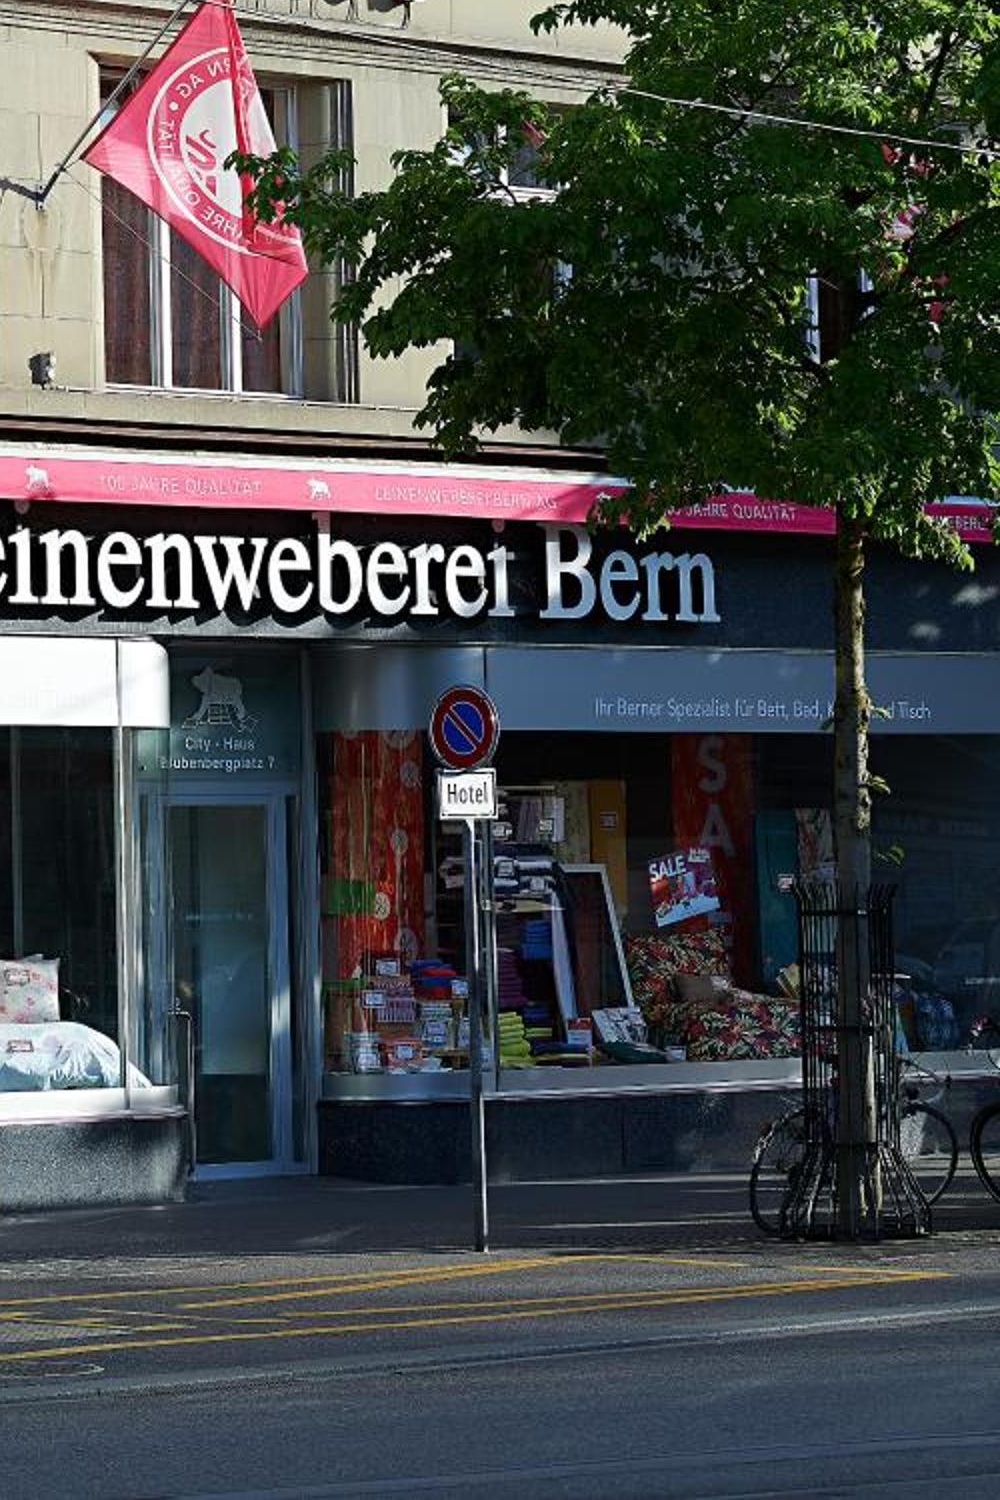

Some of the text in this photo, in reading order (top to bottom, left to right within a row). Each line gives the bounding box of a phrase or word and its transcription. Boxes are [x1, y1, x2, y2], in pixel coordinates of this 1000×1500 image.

[538, 521, 722, 623] Bern
[594, 697, 615, 717] Ihr
[617, 698, 663, 717] Berner
[667, 697, 731, 722] Spezialist
[898, 699, 931, 719] Tisch
[447, 782, 488, 804] Hotel
[649, 855, 687, 883] SALE
